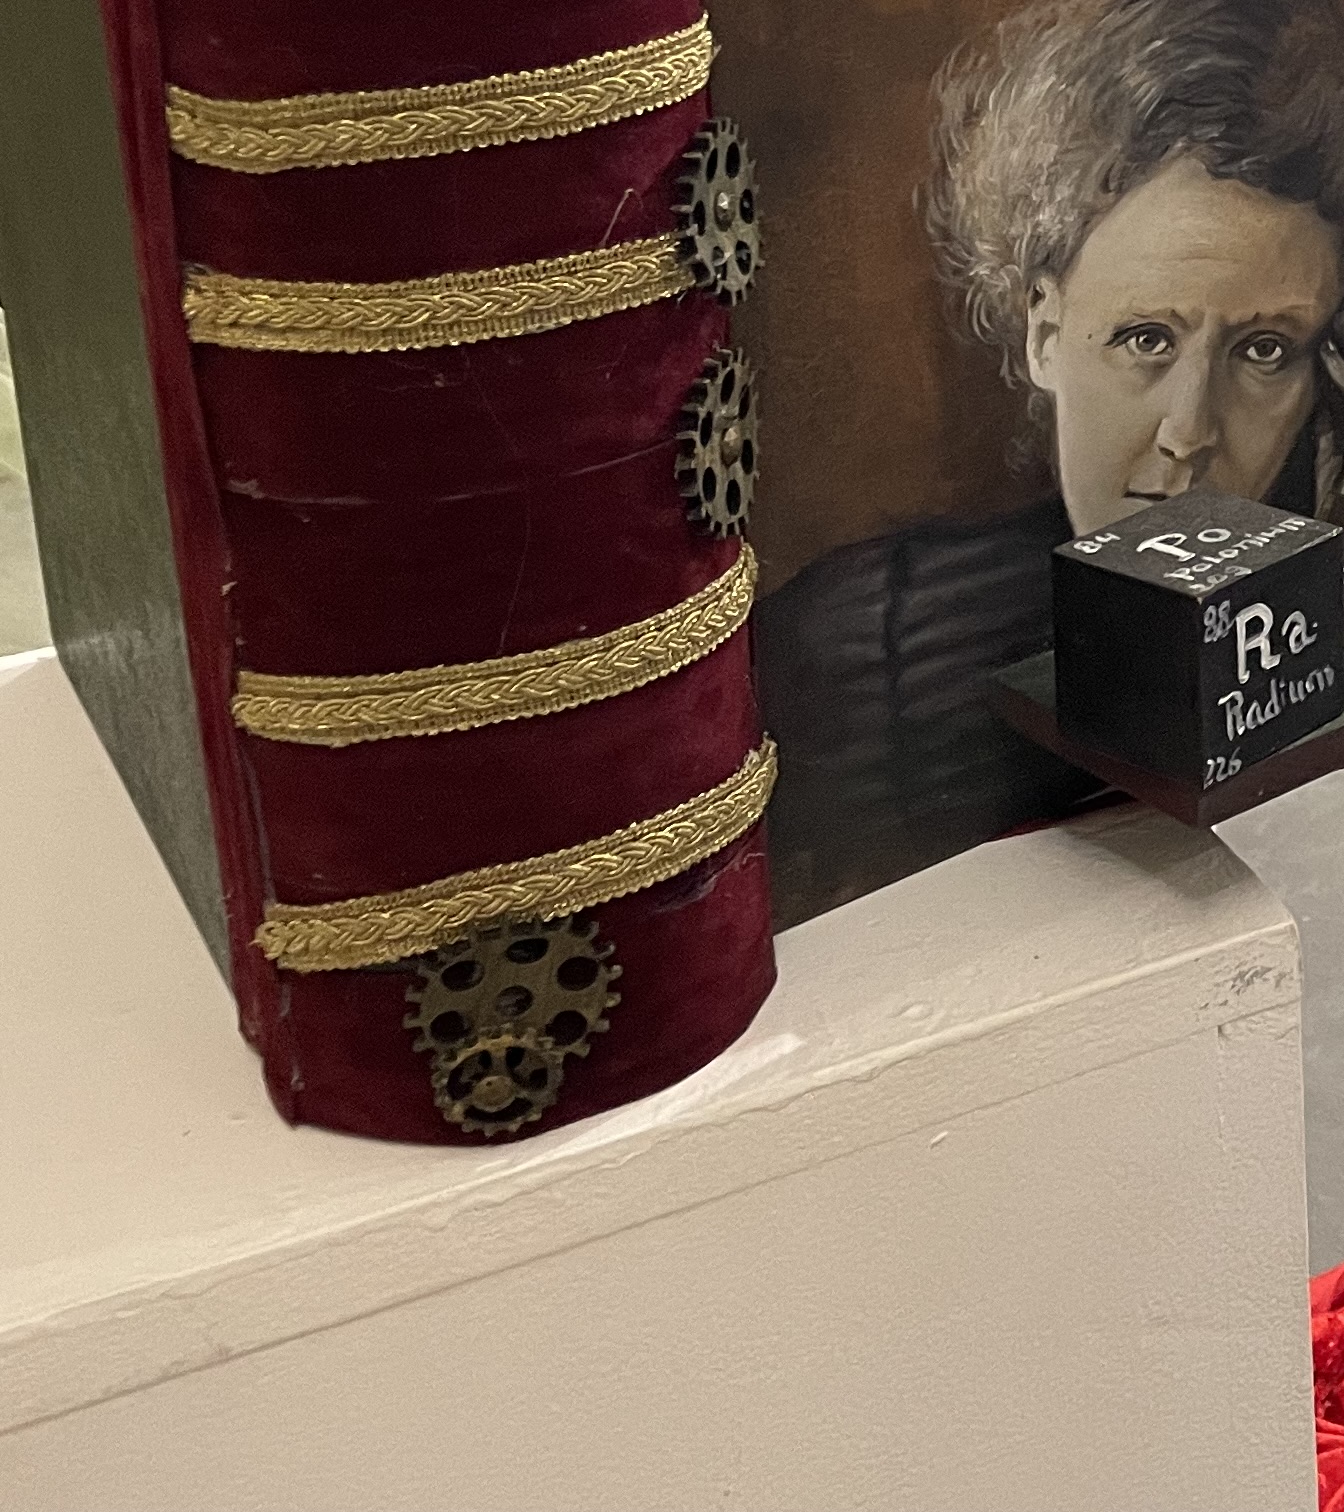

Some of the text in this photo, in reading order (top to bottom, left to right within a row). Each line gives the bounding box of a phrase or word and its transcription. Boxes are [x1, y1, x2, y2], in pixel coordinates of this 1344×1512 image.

[1073, 532, 1121, 555] 84
[1135, 527, 1232, 563] Po
[1203, 599, 1233, 643] 88
[1235, 602, 1319, 685] Ra
[1216, 663, 1336, 742] Radium
[1202, 746, 1243, 790] 226
